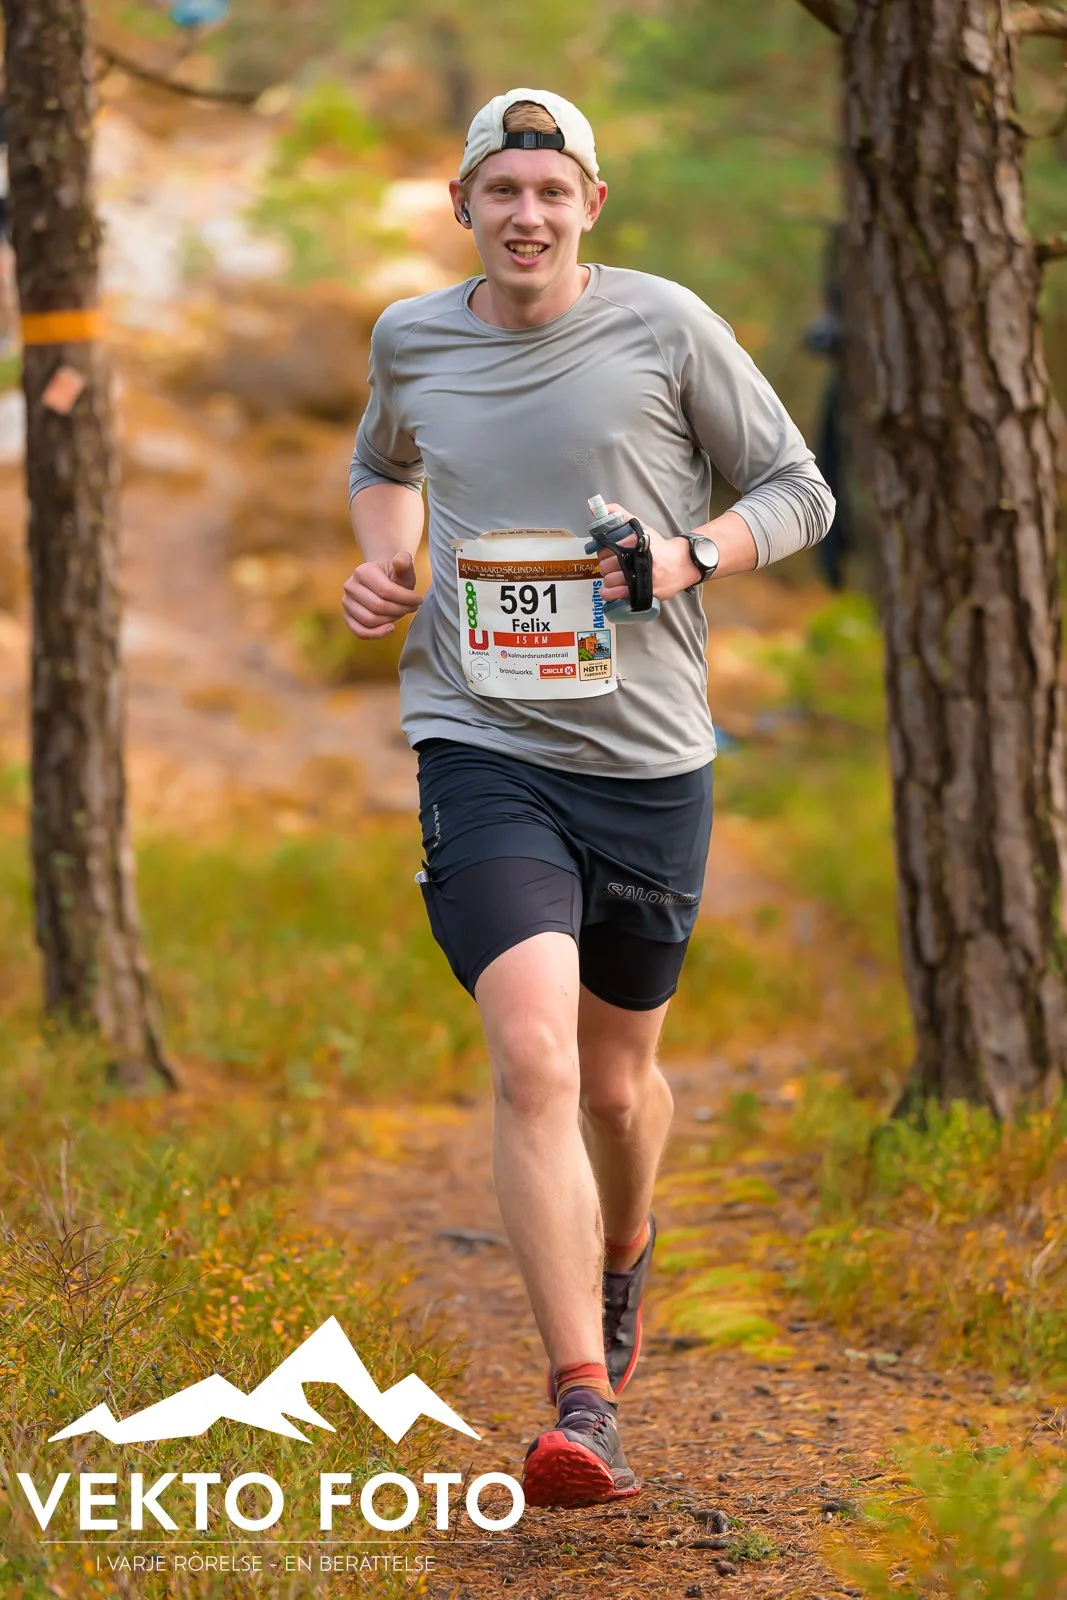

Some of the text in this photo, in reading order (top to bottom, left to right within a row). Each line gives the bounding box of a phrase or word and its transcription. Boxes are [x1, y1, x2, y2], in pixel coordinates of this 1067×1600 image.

[572, 563, 596, 572] TRAIL
[465, 581, 478, 629] coop
[500, 584, 557, 615] 591
[512, 618, 551, 632] Felix
[516, 635, 548, 645] 15 KM
[607, 882, 697, 905] SALOM
